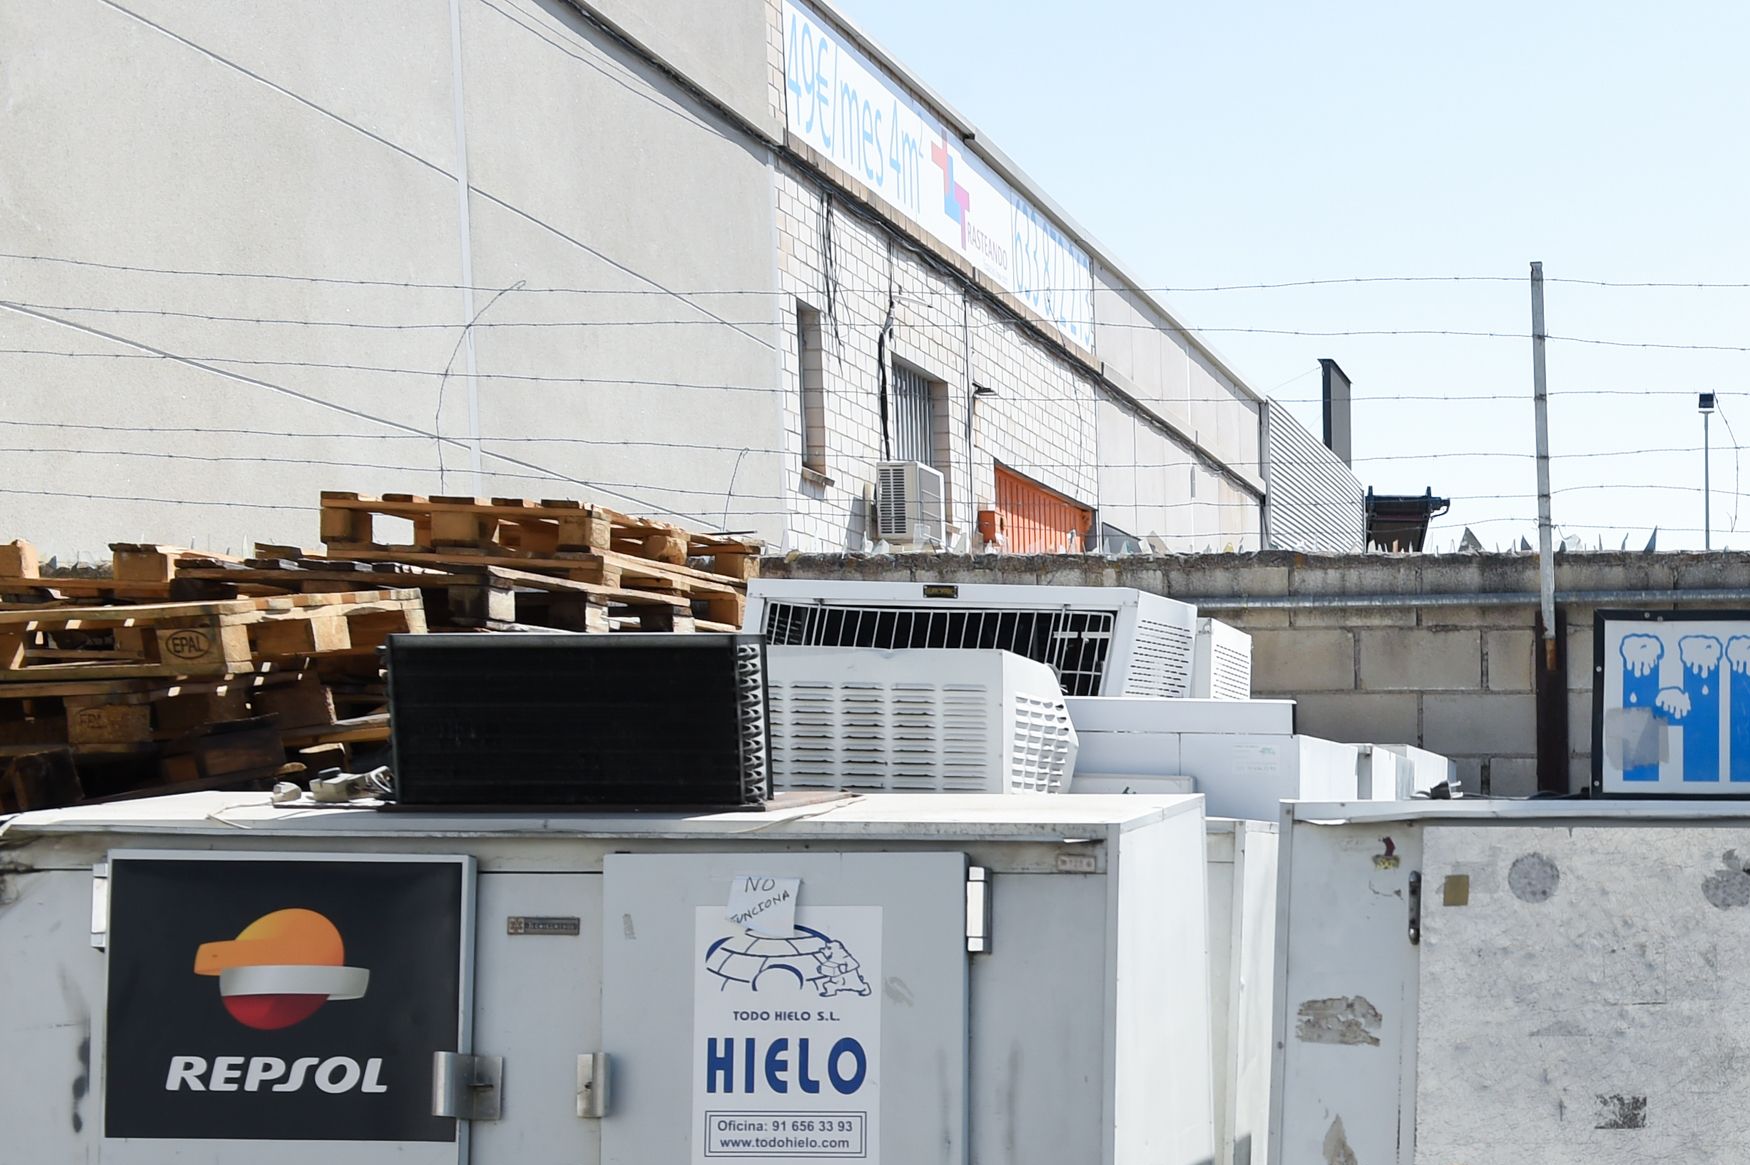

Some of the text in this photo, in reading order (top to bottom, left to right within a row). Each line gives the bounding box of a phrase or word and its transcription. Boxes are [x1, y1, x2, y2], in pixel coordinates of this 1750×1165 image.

[744, 876, 776, 893] NO
[730, 889, 790, 924] FUNCIONA
[733, 1011, 840, 1021] TODO HIELO S.L.
[706, 1036, 867, 1095] HIELO
[165, 1055, 388, 1094] REPSOL
[717, 1120, 853, 1132] Oficina: 91 656 33 93
[720, 1137, 850, 1149] www.todohielo.com
